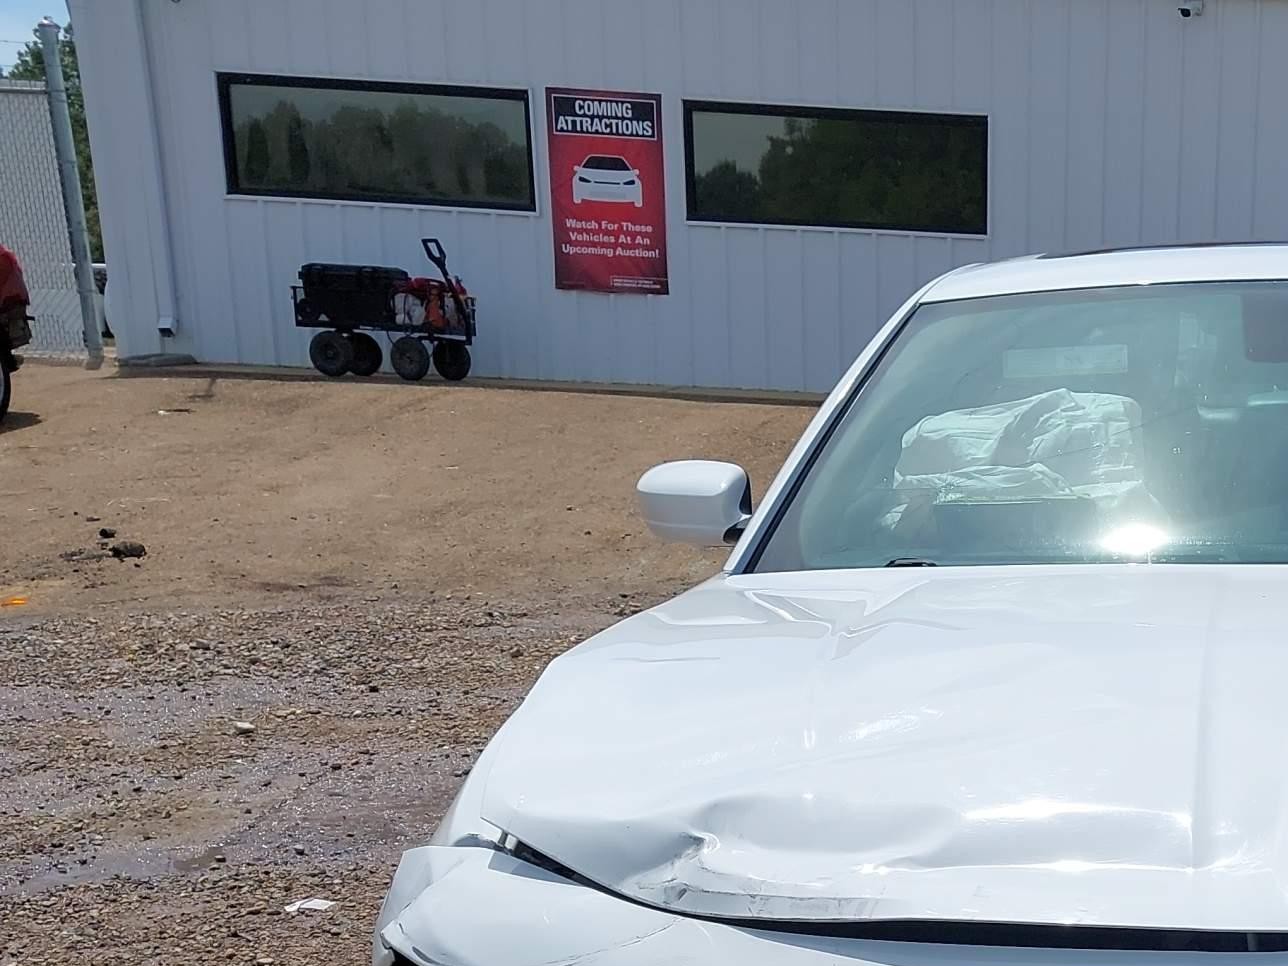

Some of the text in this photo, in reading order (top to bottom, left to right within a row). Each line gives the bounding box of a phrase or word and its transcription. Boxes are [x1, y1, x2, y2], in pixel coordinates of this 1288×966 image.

[574, 100, 632, 118] COMING
[557, 115, 653, 136] ATTRACTIONS
[565, 218, 653, 233] Watch For These
[569, 231, 650, 246] Vehicles At An
[561, 243, 660, 259] Upcoming Auction!
